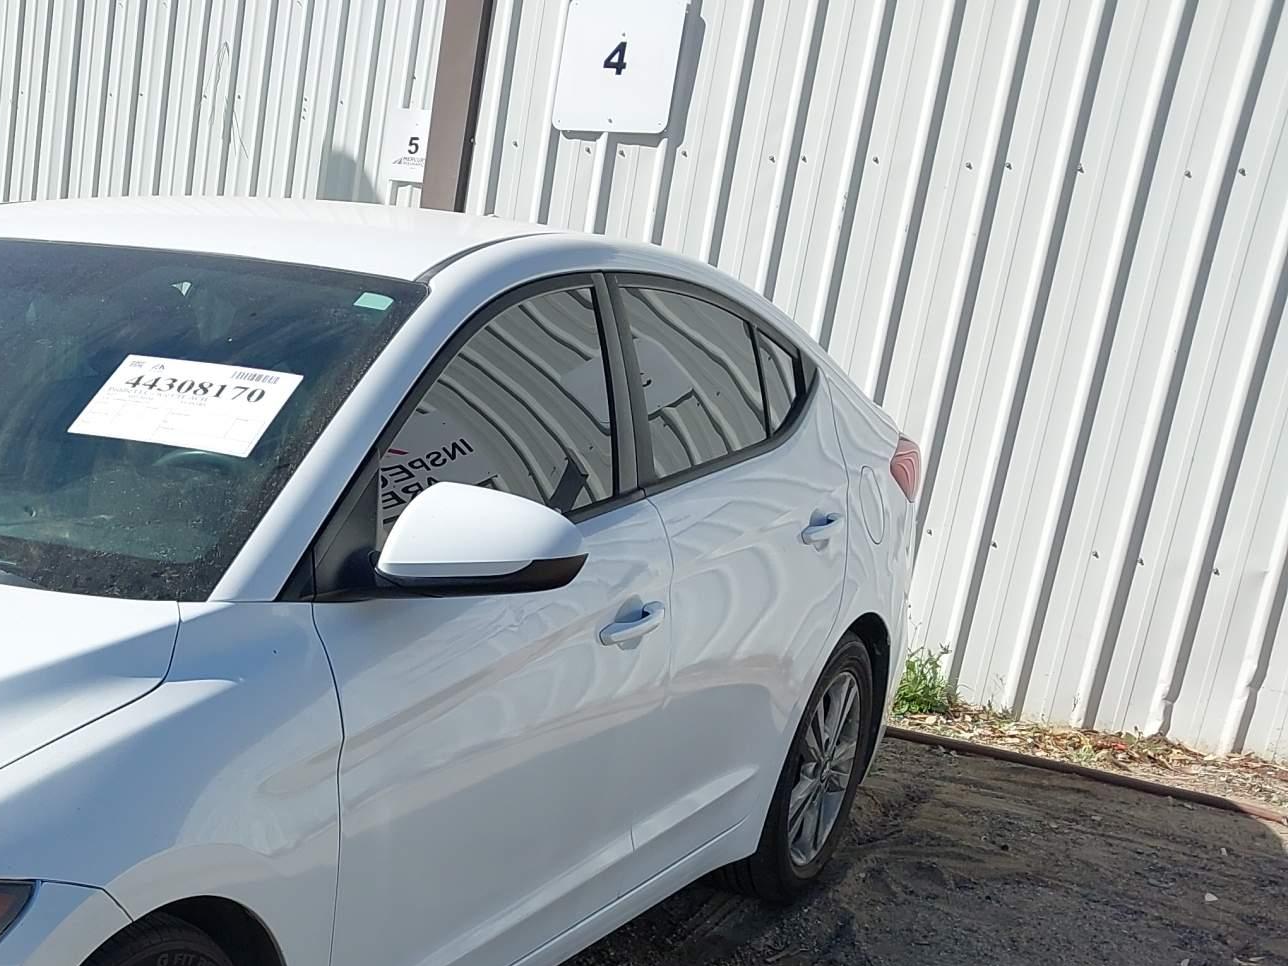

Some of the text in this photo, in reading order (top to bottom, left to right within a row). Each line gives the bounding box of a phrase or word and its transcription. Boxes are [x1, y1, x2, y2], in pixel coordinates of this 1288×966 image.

[603, 41, 627, 75] 4
[407, 136, 420, 154] 5
[125, 374, 266, 404] 44308170
